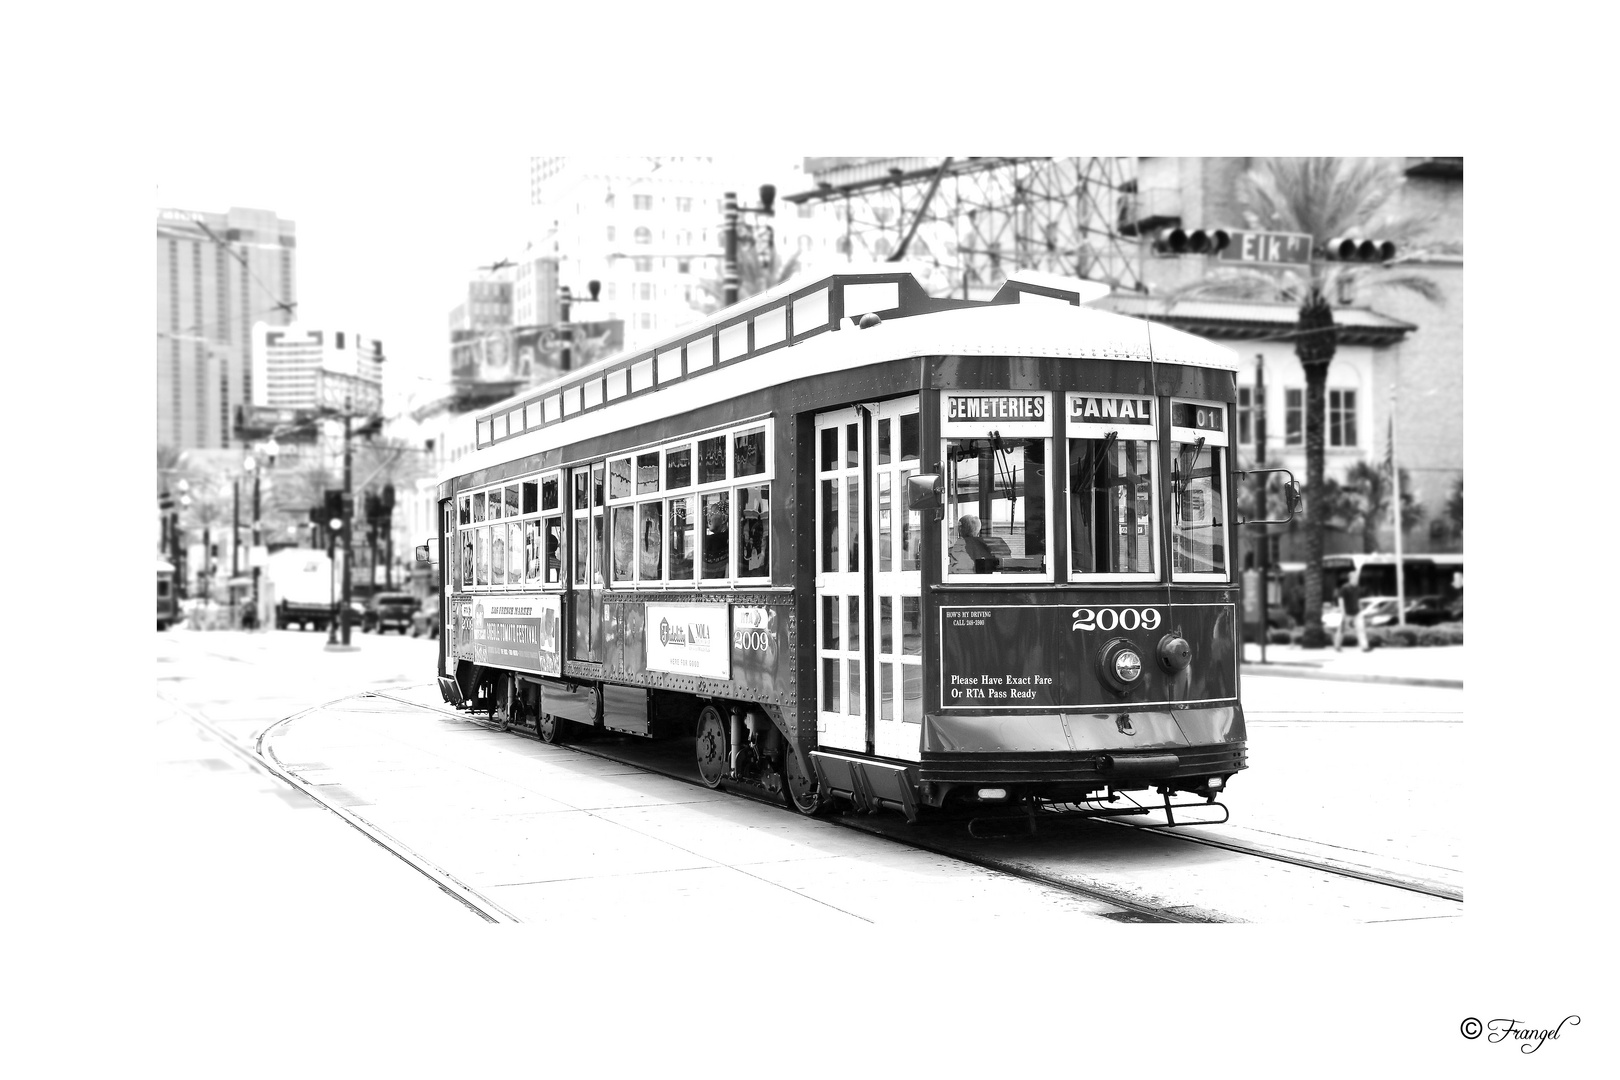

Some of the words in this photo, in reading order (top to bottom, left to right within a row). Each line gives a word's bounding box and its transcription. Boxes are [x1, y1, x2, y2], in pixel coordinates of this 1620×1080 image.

[1242, 234, 1281, 261] Elk
[948, 397, 1044, 418] CEMETERIES
[1070, 398, 1149, 419] CANAL
[1072, 608, 1162, 632] 2009
[734, 631, 768, 651] 2009
[951, 675, 978, 685] Please
[981, 675, 1003, 685] Have
[1006, 675, 1031, 685] Exact
[1034, 675, 1053, 685] Fare
[951, 688, 962, 699] Or
[966, 688, 985, 699] RTA
[988, 689, 1007, 699] Pass
[1010, 688, 1037, 700] Ready
